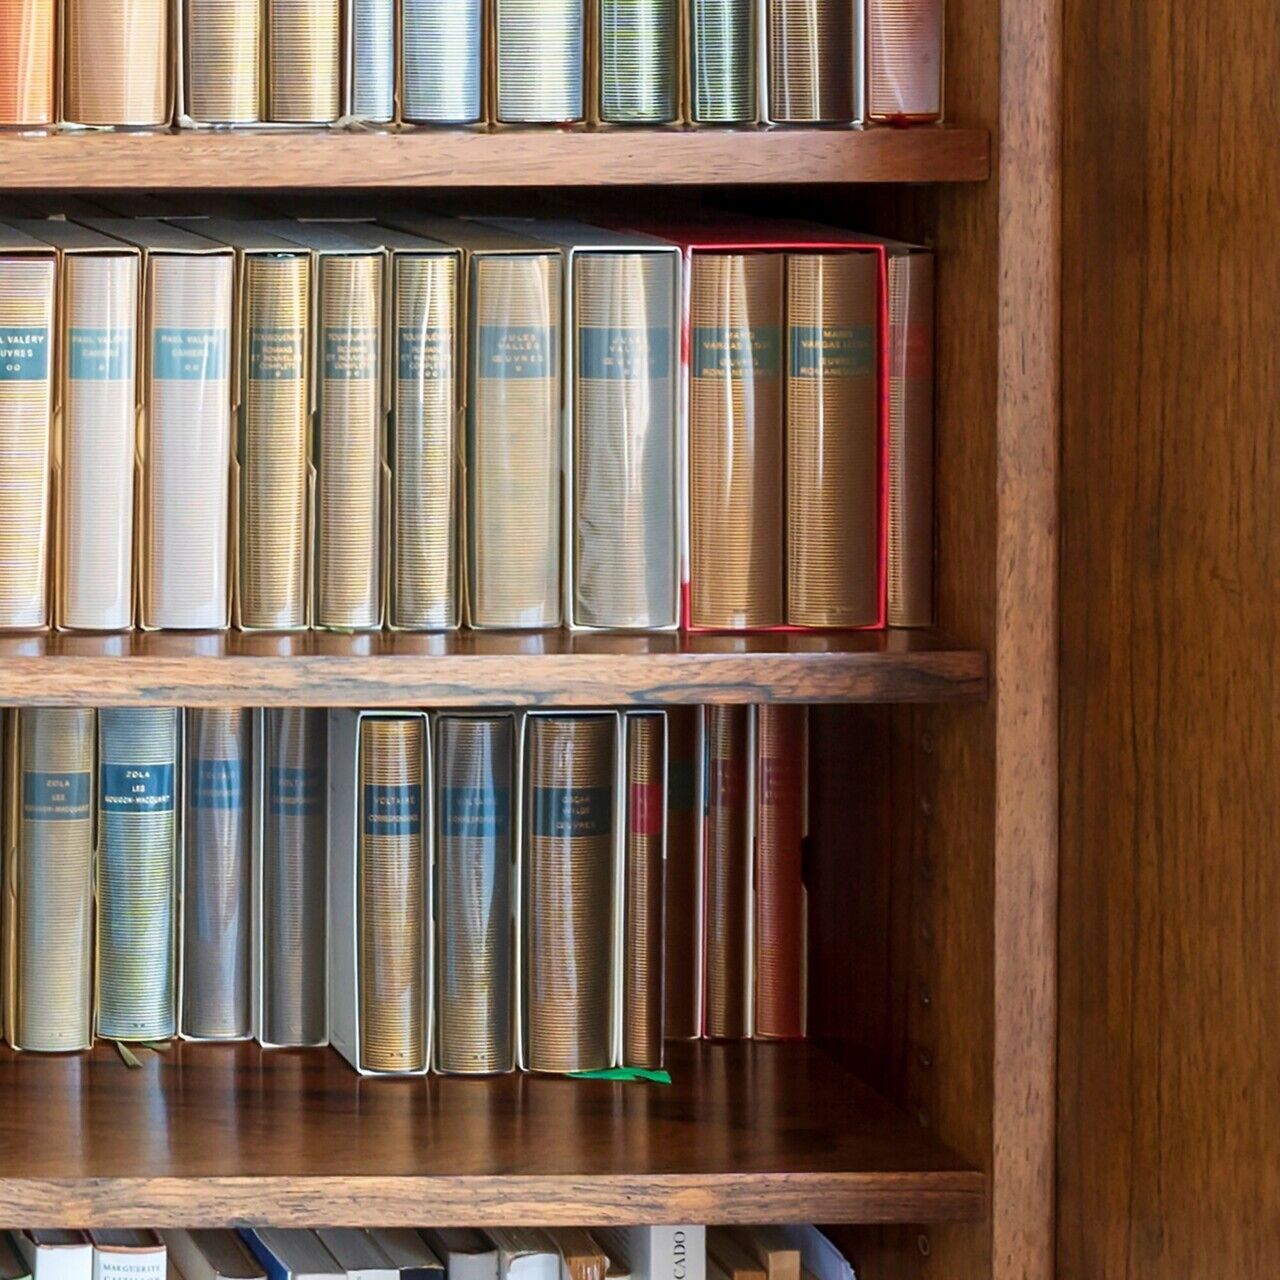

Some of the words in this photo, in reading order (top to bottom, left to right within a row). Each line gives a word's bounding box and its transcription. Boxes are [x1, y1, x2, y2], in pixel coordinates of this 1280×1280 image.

[6, 333, 44, 344] VALÉRY
[125, 770, 150, 780] ZOLA
[46, 780, 70, 788] ZOLA
[131, 785, 146, 794] LES
[103, 1262, 160, 1273] MARGUERITE
